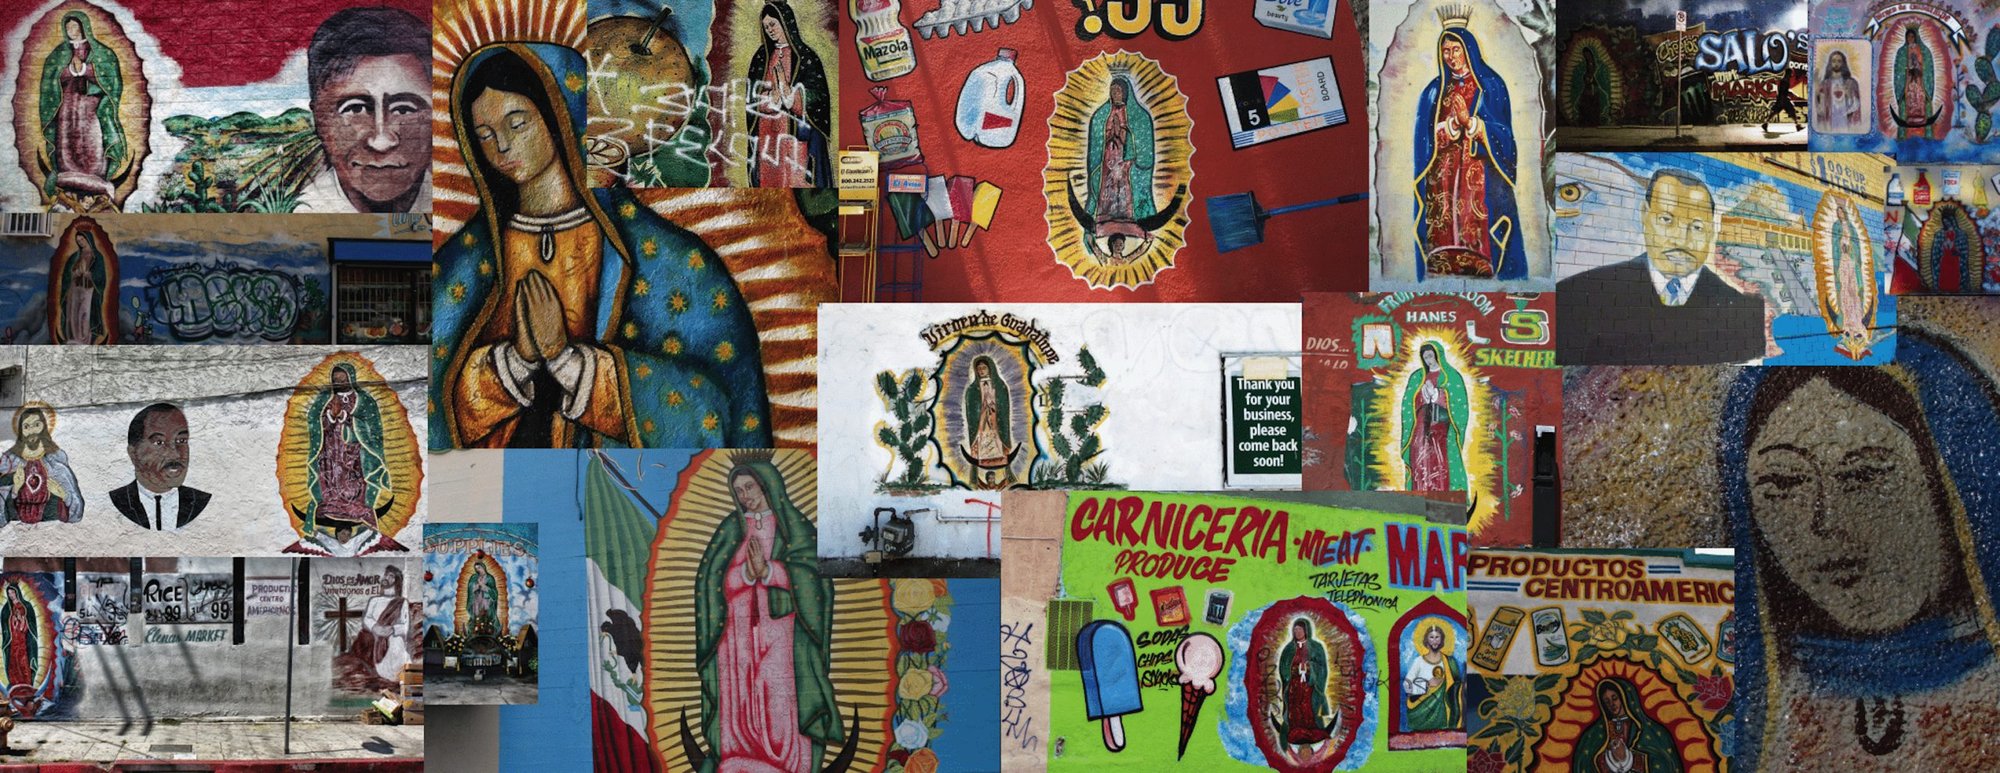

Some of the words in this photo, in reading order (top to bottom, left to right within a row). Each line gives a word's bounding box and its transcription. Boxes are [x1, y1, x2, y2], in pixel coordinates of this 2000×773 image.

[863, 39, 909, 60] Mazola
[1317, 71, 1330, 101] BOARD
[1248, 109, 1261, 126] 5
[1406, 311, 1457, 323] HANES
[1237, 378, 1273, 390] Thank
[1274, 380, 1295, 393] you
[1245, 393, 1262, 405] for
[1265, 396, 1291, 408] your
[1243, 408, 1294, 422] business,
[1250, 423, 1287, 439] please
[1238, 441, 1270, 451] come
[1271, 438, 1298, 451] back
[1253, 454, 1284, 467] soon!
[1071, 496, 1289, 564] CARNICERIA
[423, 539, 526, 557] SUPPLIES
[1114, 549, 1237, 583] PRODUCE
[1467, 555, 1645, 579] PRODUCTOS
[1309, 569, 1382, 590] TARJETAS
[1524, 577, 1735, 605] CENTROAMERIC
[210, 601, 230, 620] 99
[184, 629, 228, 643] MARKET
[1136, 624, 1190, 648] SODAS
